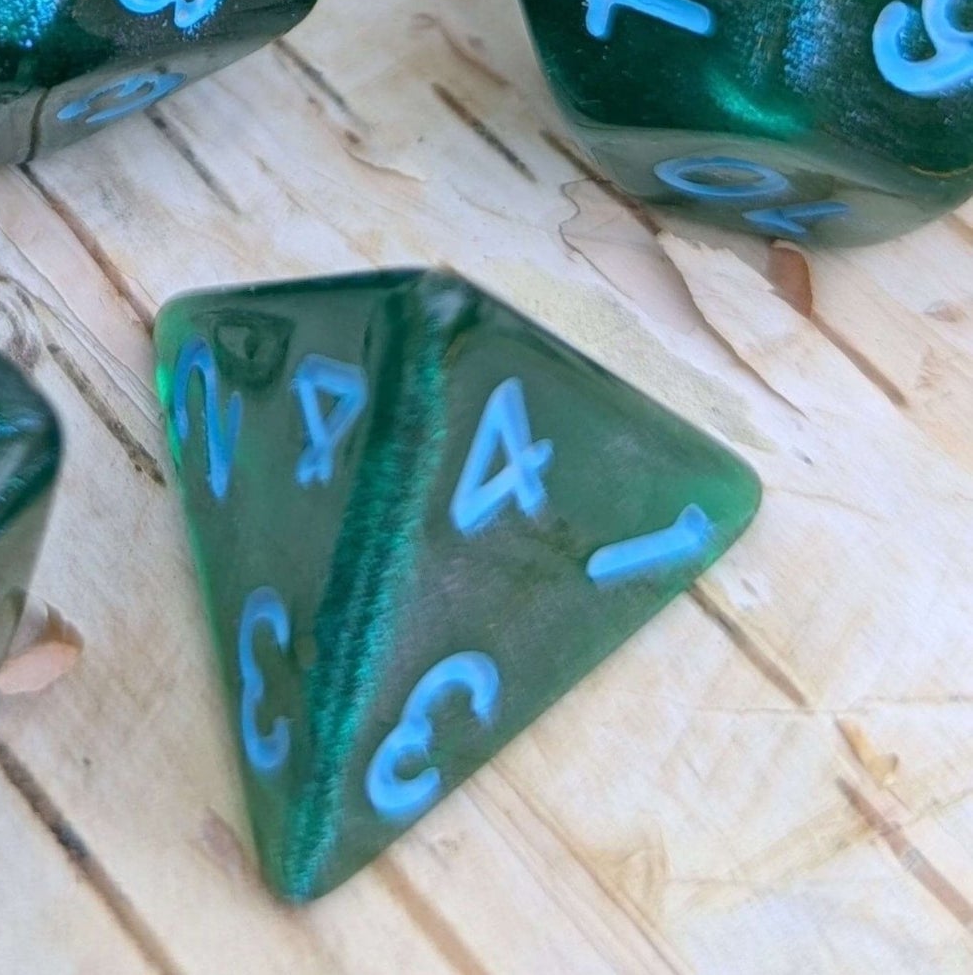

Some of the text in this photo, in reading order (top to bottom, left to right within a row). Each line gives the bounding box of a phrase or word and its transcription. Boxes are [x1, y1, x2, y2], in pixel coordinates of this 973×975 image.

[292, 353, 370, 488] 4
[449, 375, 554, 537] 4
[586, 503, 717, 588] 1
[238, 585, 291, 775] 3
[365, 650, 503, 822] 3
